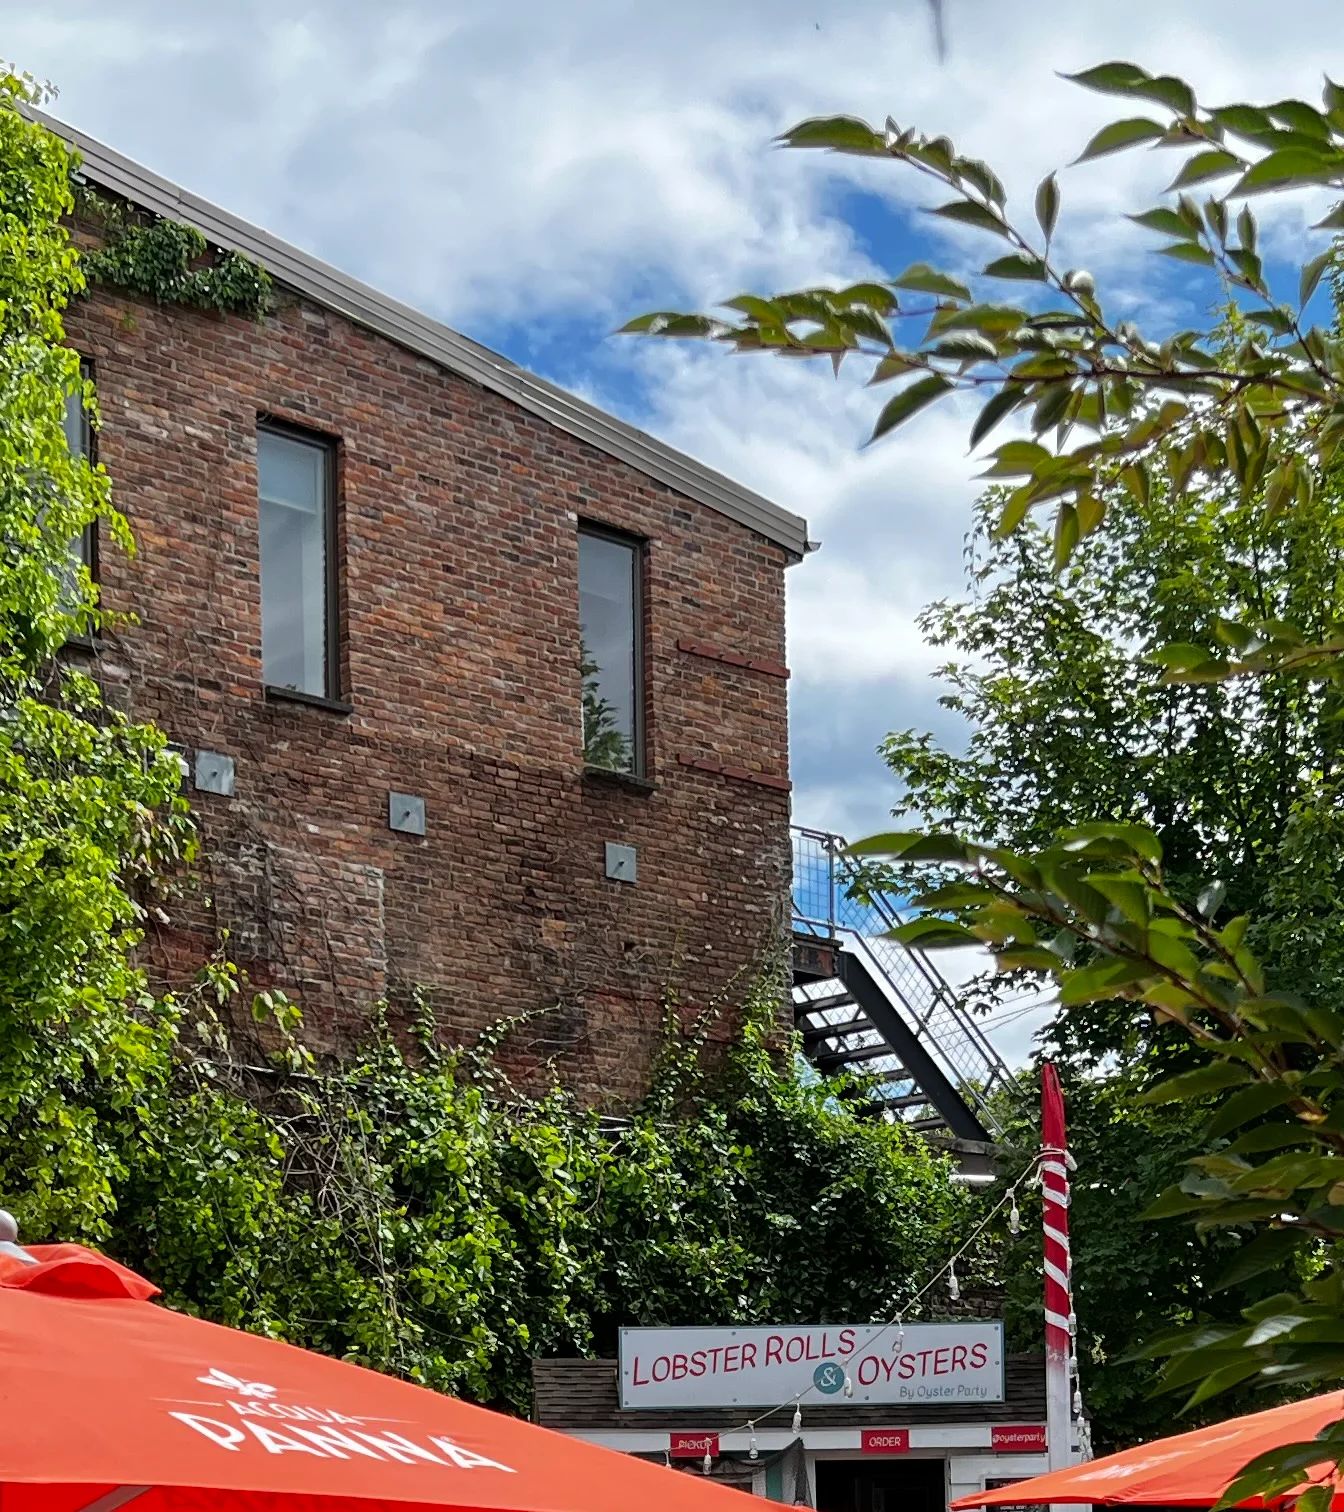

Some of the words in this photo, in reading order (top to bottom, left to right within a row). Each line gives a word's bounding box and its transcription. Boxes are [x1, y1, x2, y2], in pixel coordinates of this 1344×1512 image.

[632, 1343, 757, 1386] LOBSTER
[764, 1328, 856, 1367] ROLLS
[820, 1367, 837, 1388] &
[858, 1342, 988, 1386] OYSTERS
[900, 1386, 914, 1400] By
[917, 1385, 956, 1399] Oyster
[957, 1384, 988, 1398] Party
[225, 1399, 367, 1427] ACQUA
[167, 1411, 519, 1474] PANNA
[868, 1436, 901, 1447] ORDER
